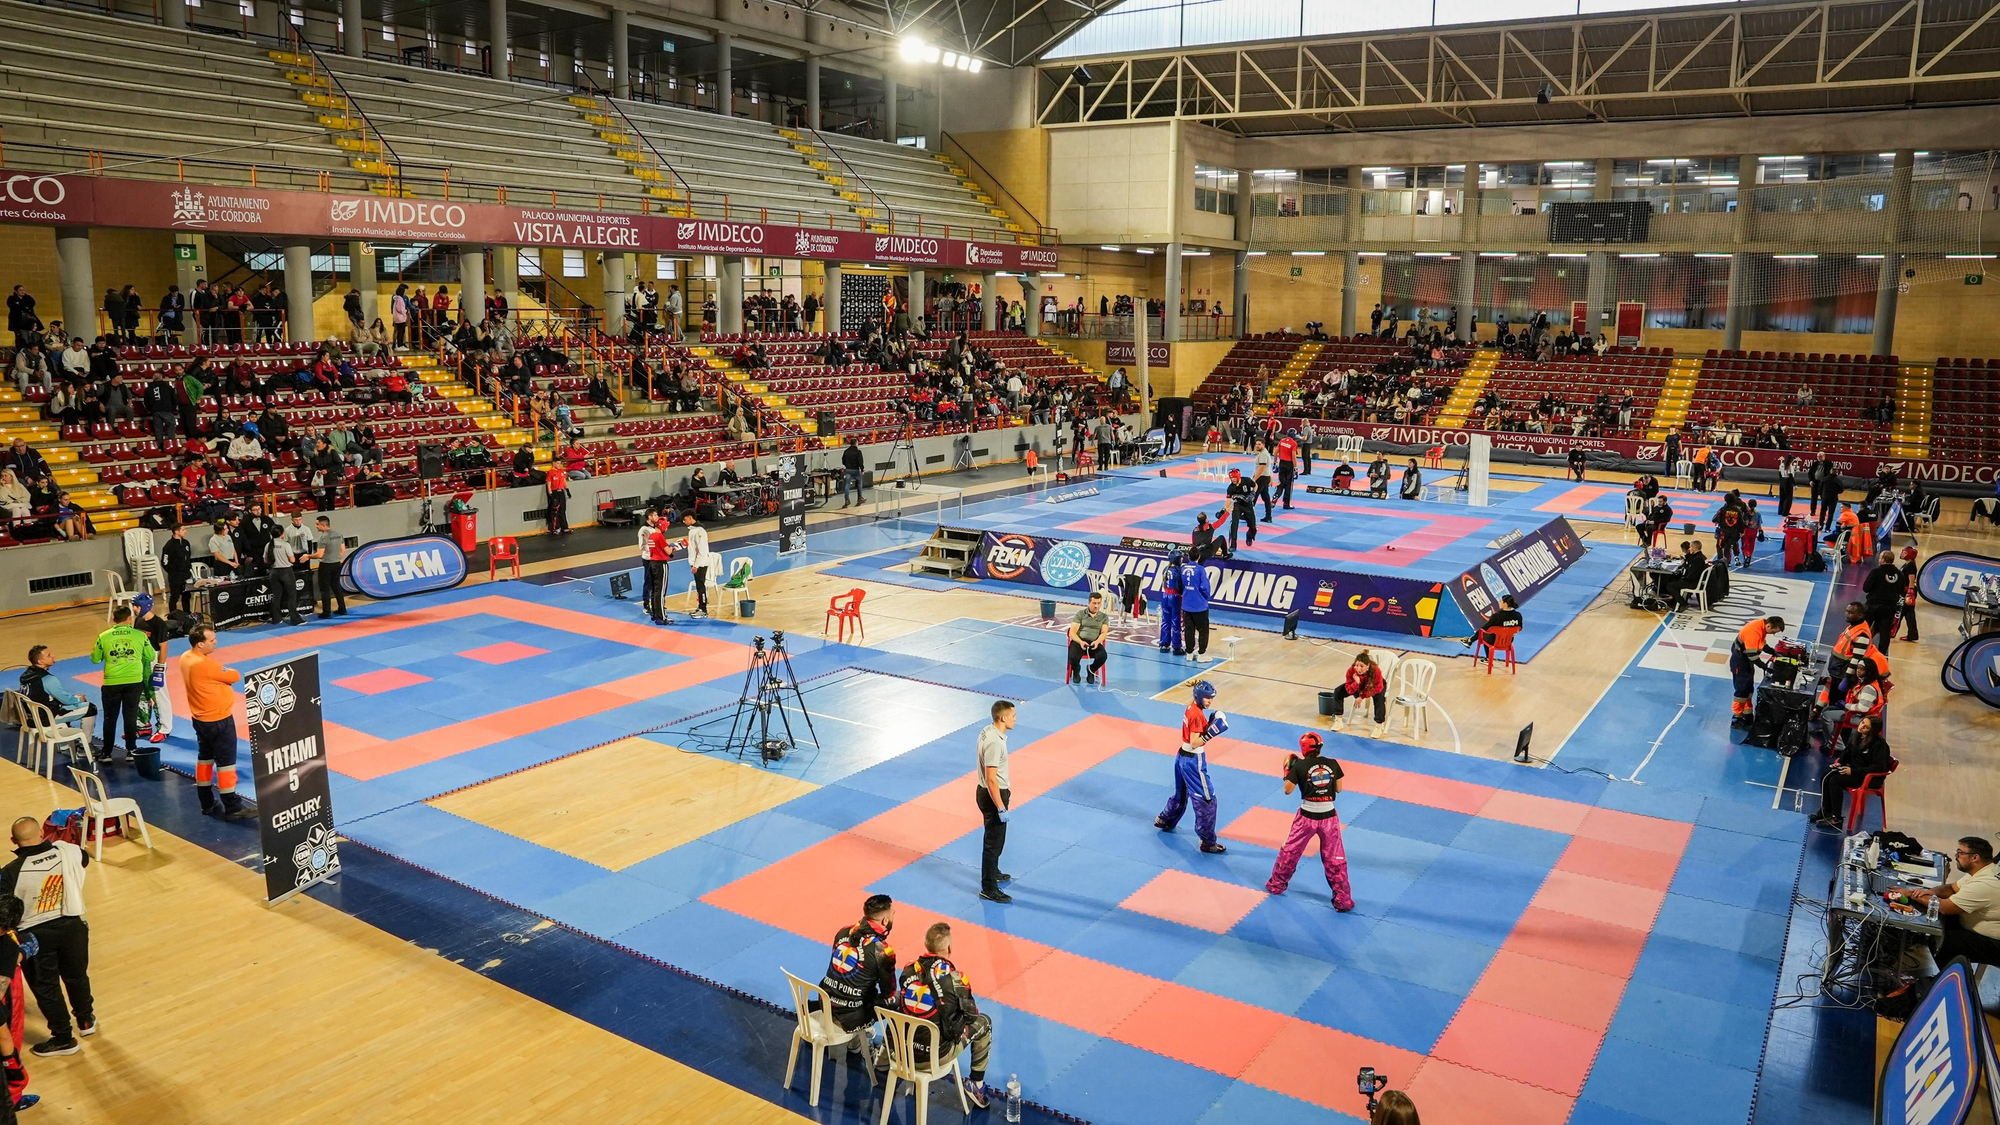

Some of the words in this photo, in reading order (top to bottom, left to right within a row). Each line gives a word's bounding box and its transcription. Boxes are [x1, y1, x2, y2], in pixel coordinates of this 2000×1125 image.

[0, 175, 65, 204] CO
[207, 196, 270, 210] AYUNTAMIENTO
[22, 209, 66, 220] Córdoba
[208, 210, 219, 221] DE
[221, 209, 262, 223] CÓRDOBA
[364, 200, 466, 228] IMDECO
[521, 211, 555, 221] PALACIO
[556, 213, 595, 223] MUNICIPAL
[597, 216, 631, 226] DEPORTES
[332, 226, 361, 235] Instituto
[363, 227, 396, 237] Municipal
[398, 229, 407, 237] de
[408, 231, 438, 239] Deportes
[438, 231, 466, 240] Córdoba
[513, 222, 567, 243] VISTA
[572, 226, 640, 247] ALEGRE
[698, 223, 764, 244] IMDECO
[811, 235, 839, 245] AYUNTAMIENTO
[181, 246, 191, 258] B
[697, 244, 719, 252] Municipal
[811, 244, 819, 252] DE
[820, 243, 835, 253] CÓRDOBA
[890, 236, 938, 256] IMDECO
[980, 248, 1003, 258] Diputación
[1029, 250, 1057, 263] IMDECO
[772, 267, 778, 276] D
[1121, 346, 1168, 359] IMECO
[1318, 426, 1354, 436] AYUNTAMIENTO
[1393, 428, 1470, 446] IMDECO
[1496, 434, 1528, 443] PALACIO
[1528, 436, 1568, 445] MUNICIPAL
[986, 545, 1035, 567] FEKM
[373, 549, 447, 585] FEKM
[265, 735, 318, 774] TATAMI
[288, 769, 300, 792] 5
[272, 795, 322, 829] CENTURY
[277, 820, 303, 834] MARTIAL
[304, 810, 319, 822] ARTS
